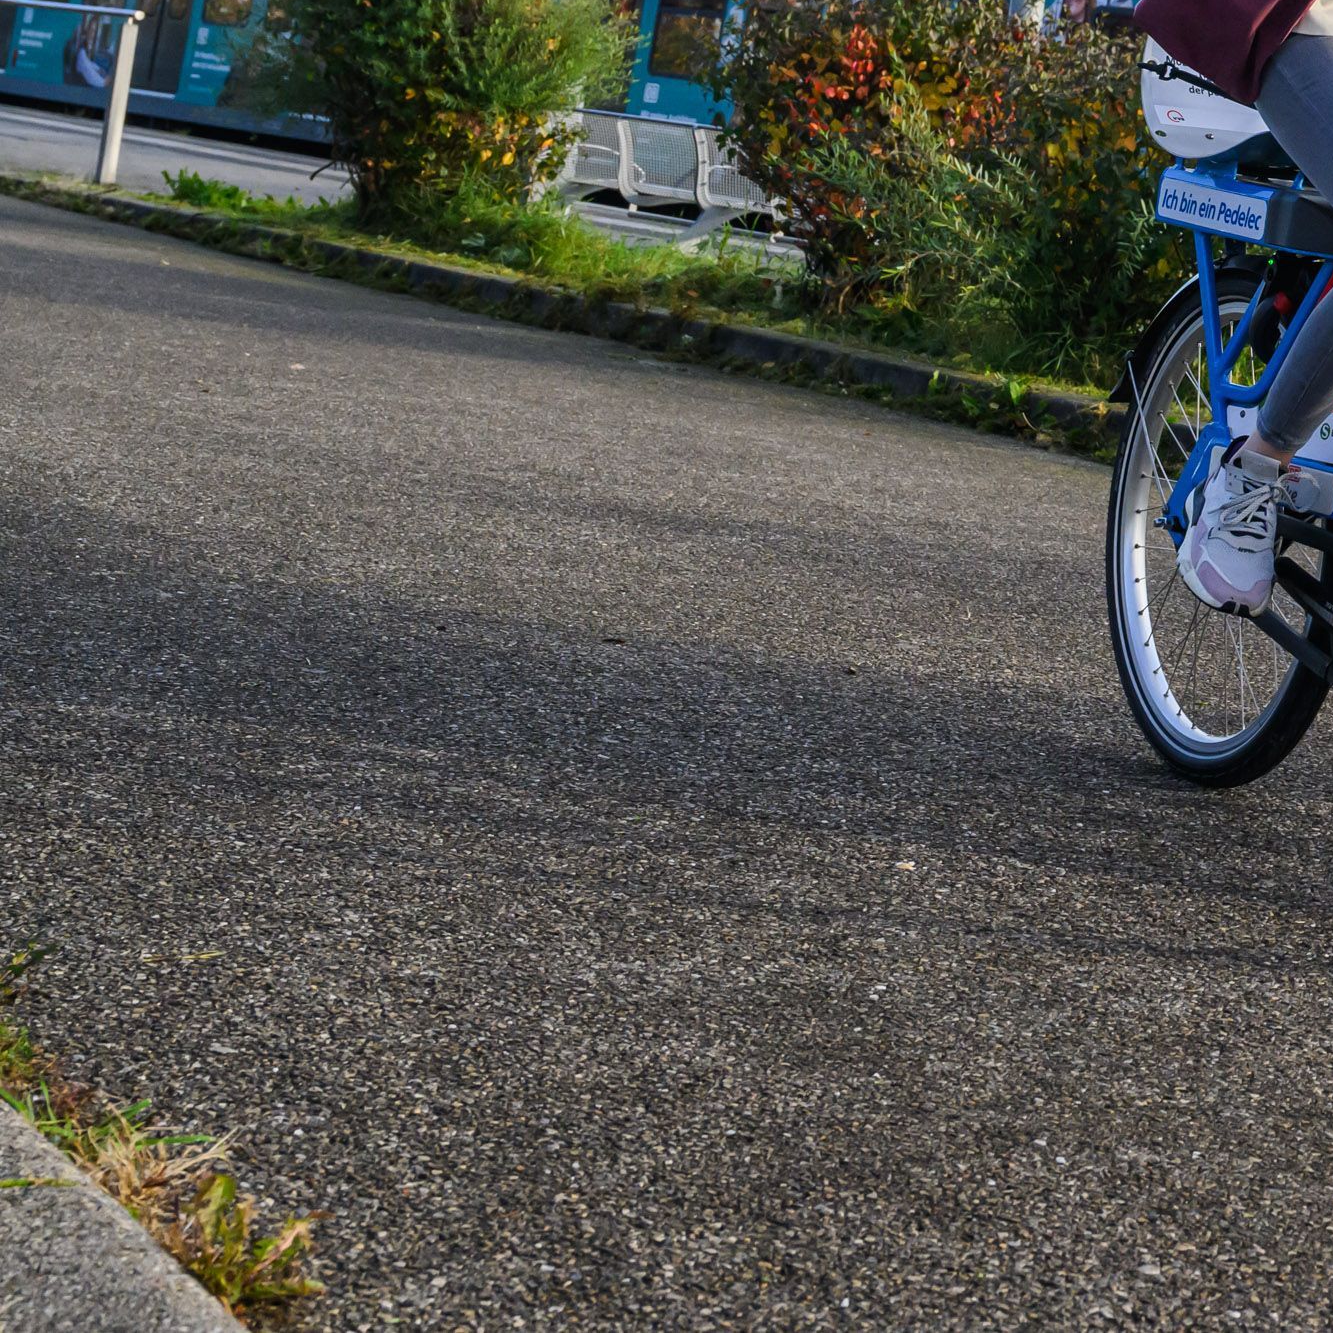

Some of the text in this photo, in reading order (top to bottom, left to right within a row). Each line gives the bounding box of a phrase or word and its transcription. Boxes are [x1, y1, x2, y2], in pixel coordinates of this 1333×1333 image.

[1162, 189, 1262, 230] Ich bin ein Pedelec
